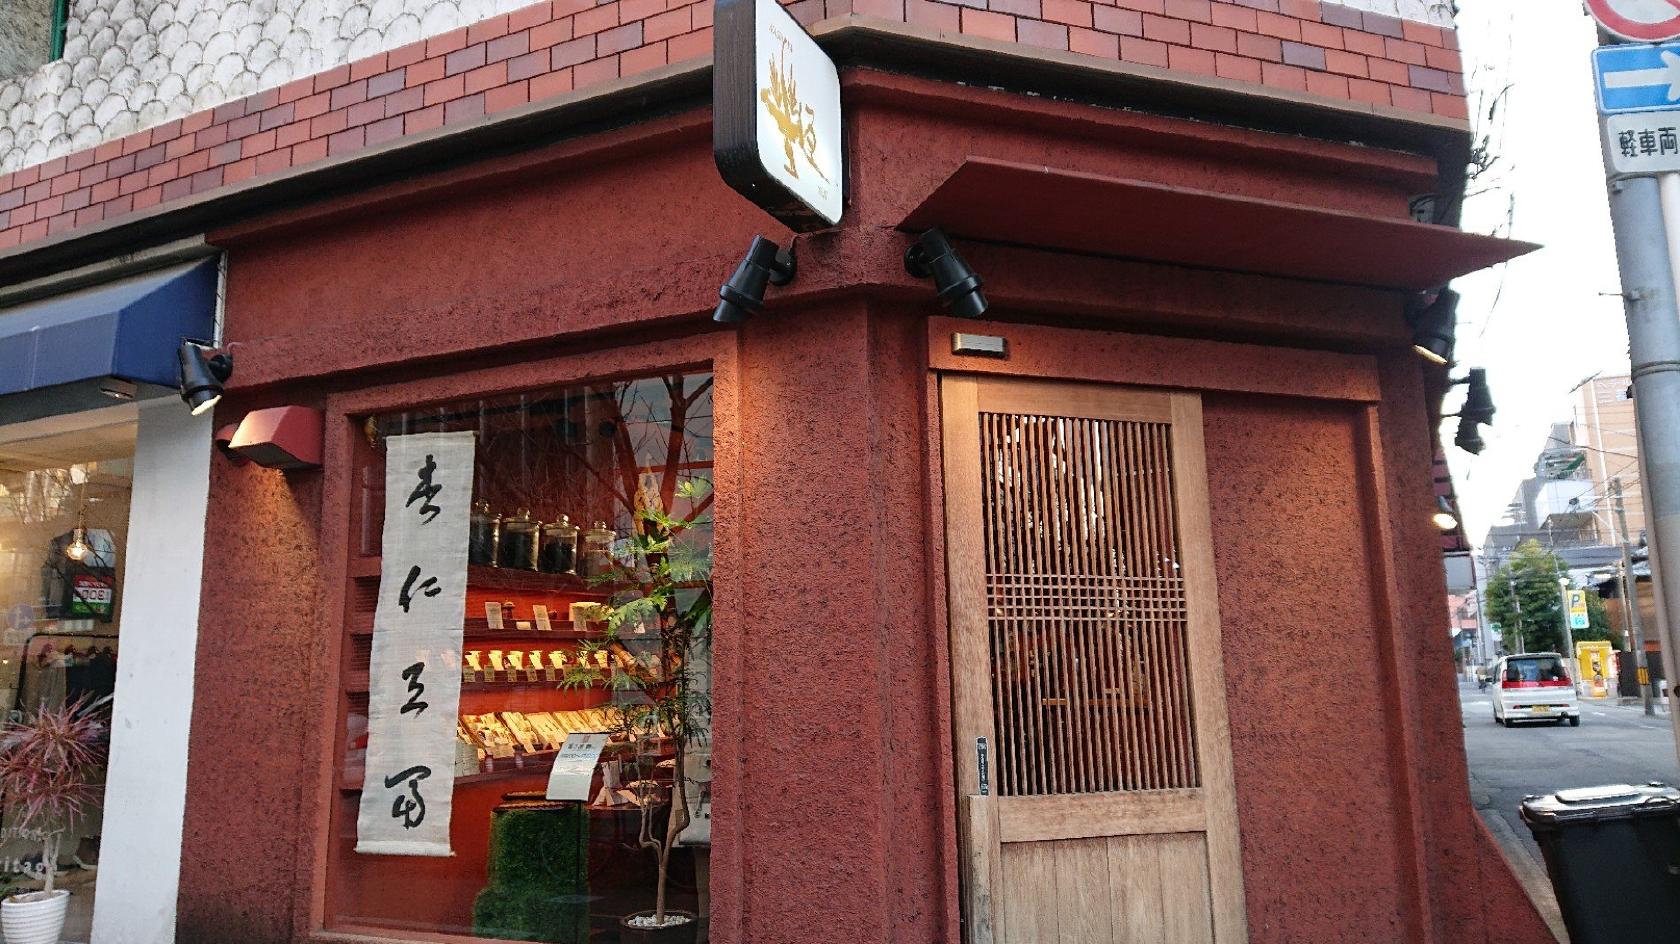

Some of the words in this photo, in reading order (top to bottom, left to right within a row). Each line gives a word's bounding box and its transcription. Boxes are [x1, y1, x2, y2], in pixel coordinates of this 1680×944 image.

[1617, 127, 1679, 157] 軽車両
[1571, 593, 1580, 608] P
